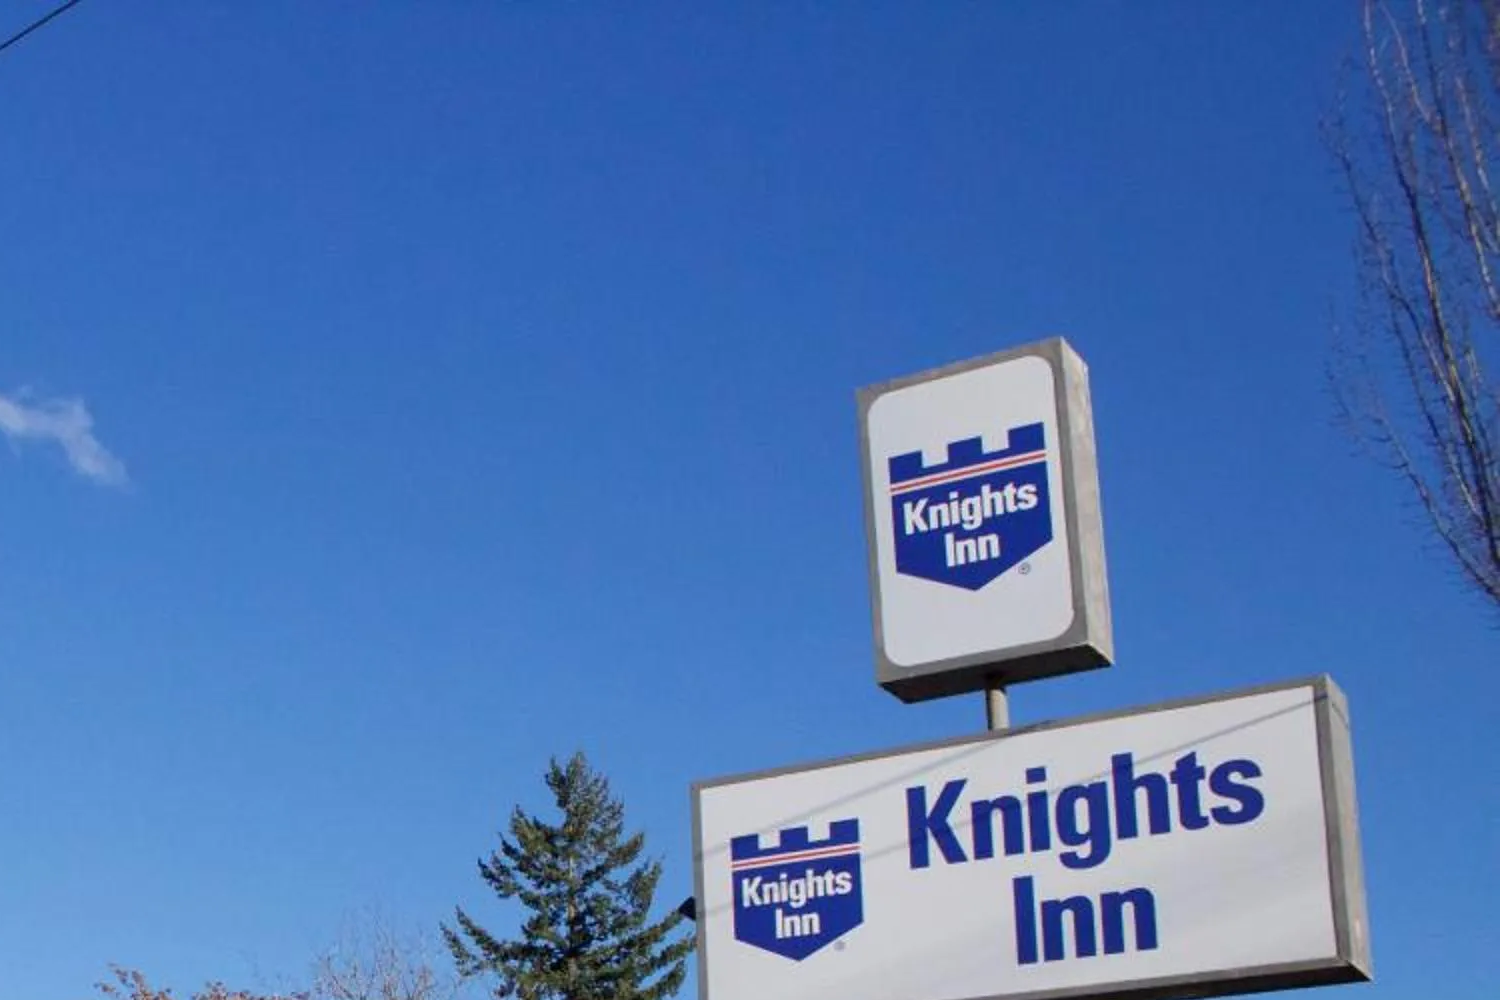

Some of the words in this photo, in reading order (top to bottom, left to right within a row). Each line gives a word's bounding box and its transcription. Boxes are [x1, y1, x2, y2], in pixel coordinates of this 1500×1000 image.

[902, 481, 1039, 536] Knights
[944, 531, 1001, 568] Inn
[905, 751, 1266, 870] Knights
[741, 867, 853, 909] Knights
[775, 907, 821, 940] Inn
[1012, 874, 1159, 966] Inn
